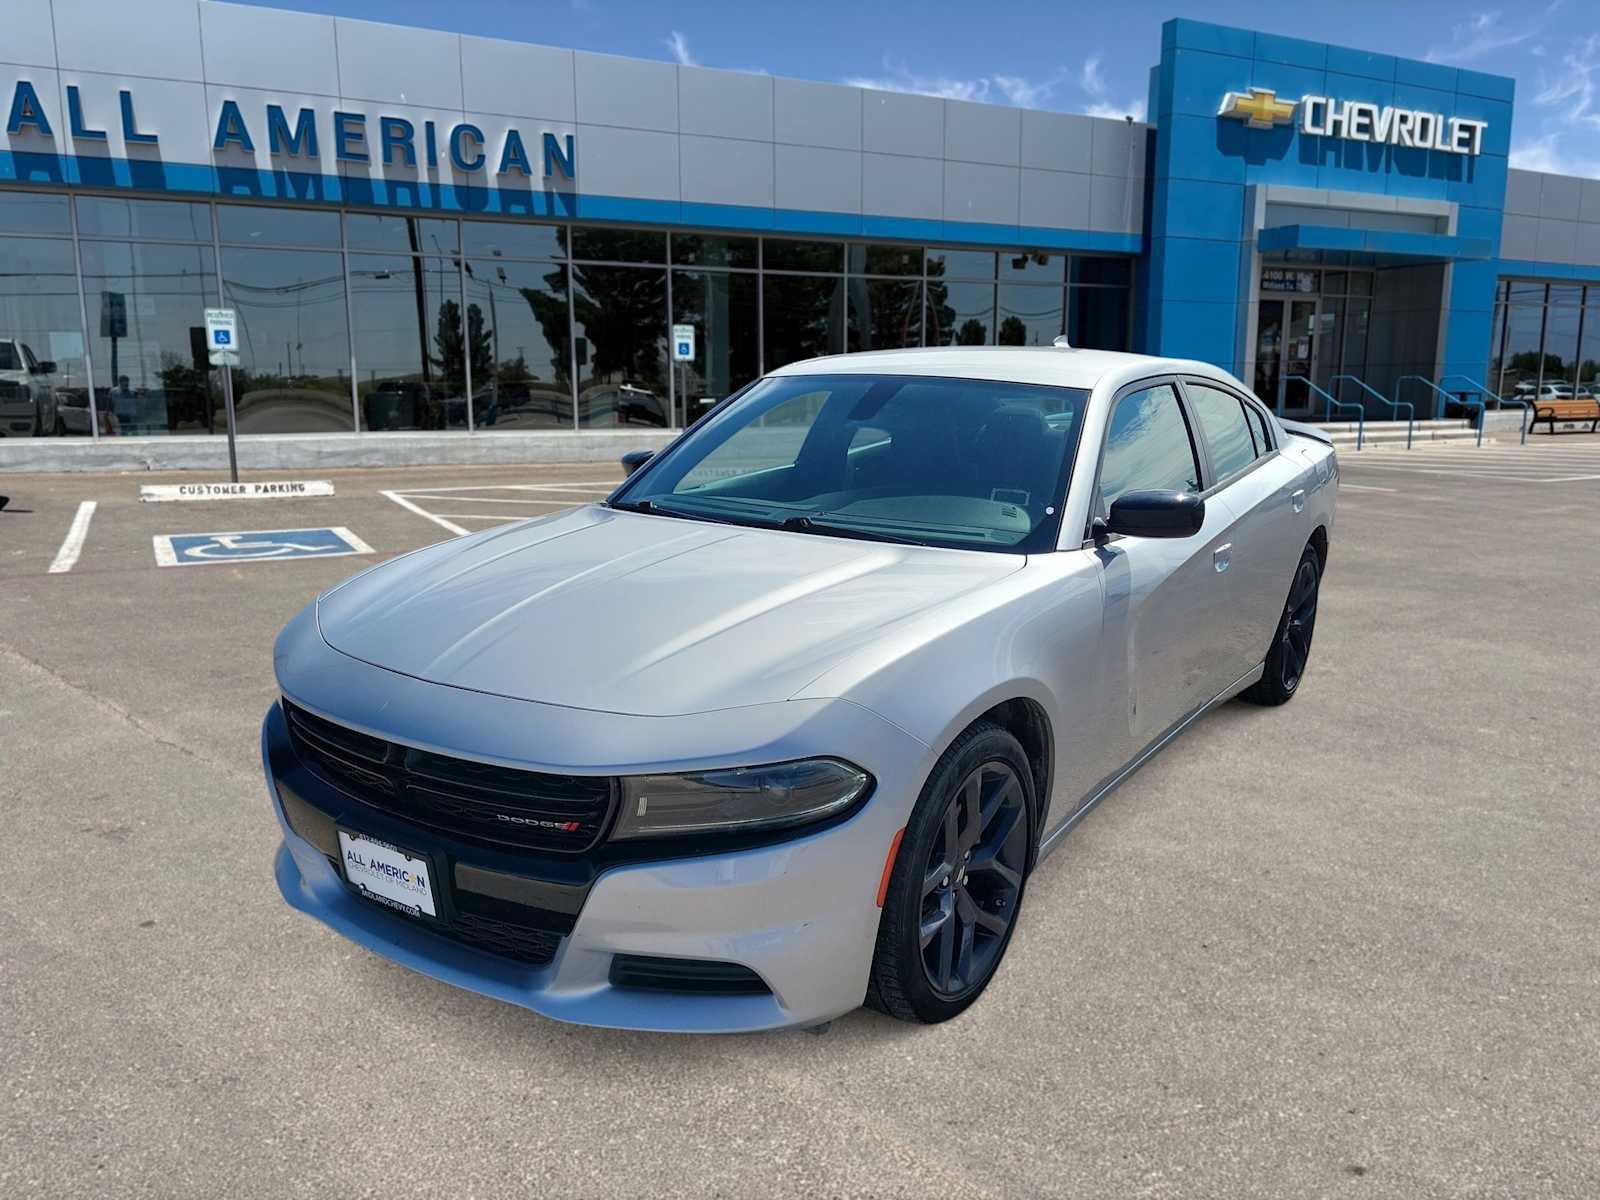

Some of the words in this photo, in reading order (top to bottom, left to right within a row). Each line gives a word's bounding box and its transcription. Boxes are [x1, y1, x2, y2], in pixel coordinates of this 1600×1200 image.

[6, 80, 159, 144] ALL
[213, 99, 576, 179] AMERICAN
[1301, 94, 1488, 156] CHEVROLET
[179, 485, 247, 495] CUSTOMER
[254, 483, 306, 494] PARKING
[496, 814, 568, 830] DODGE
[347, 849, 365, 866] ALL
